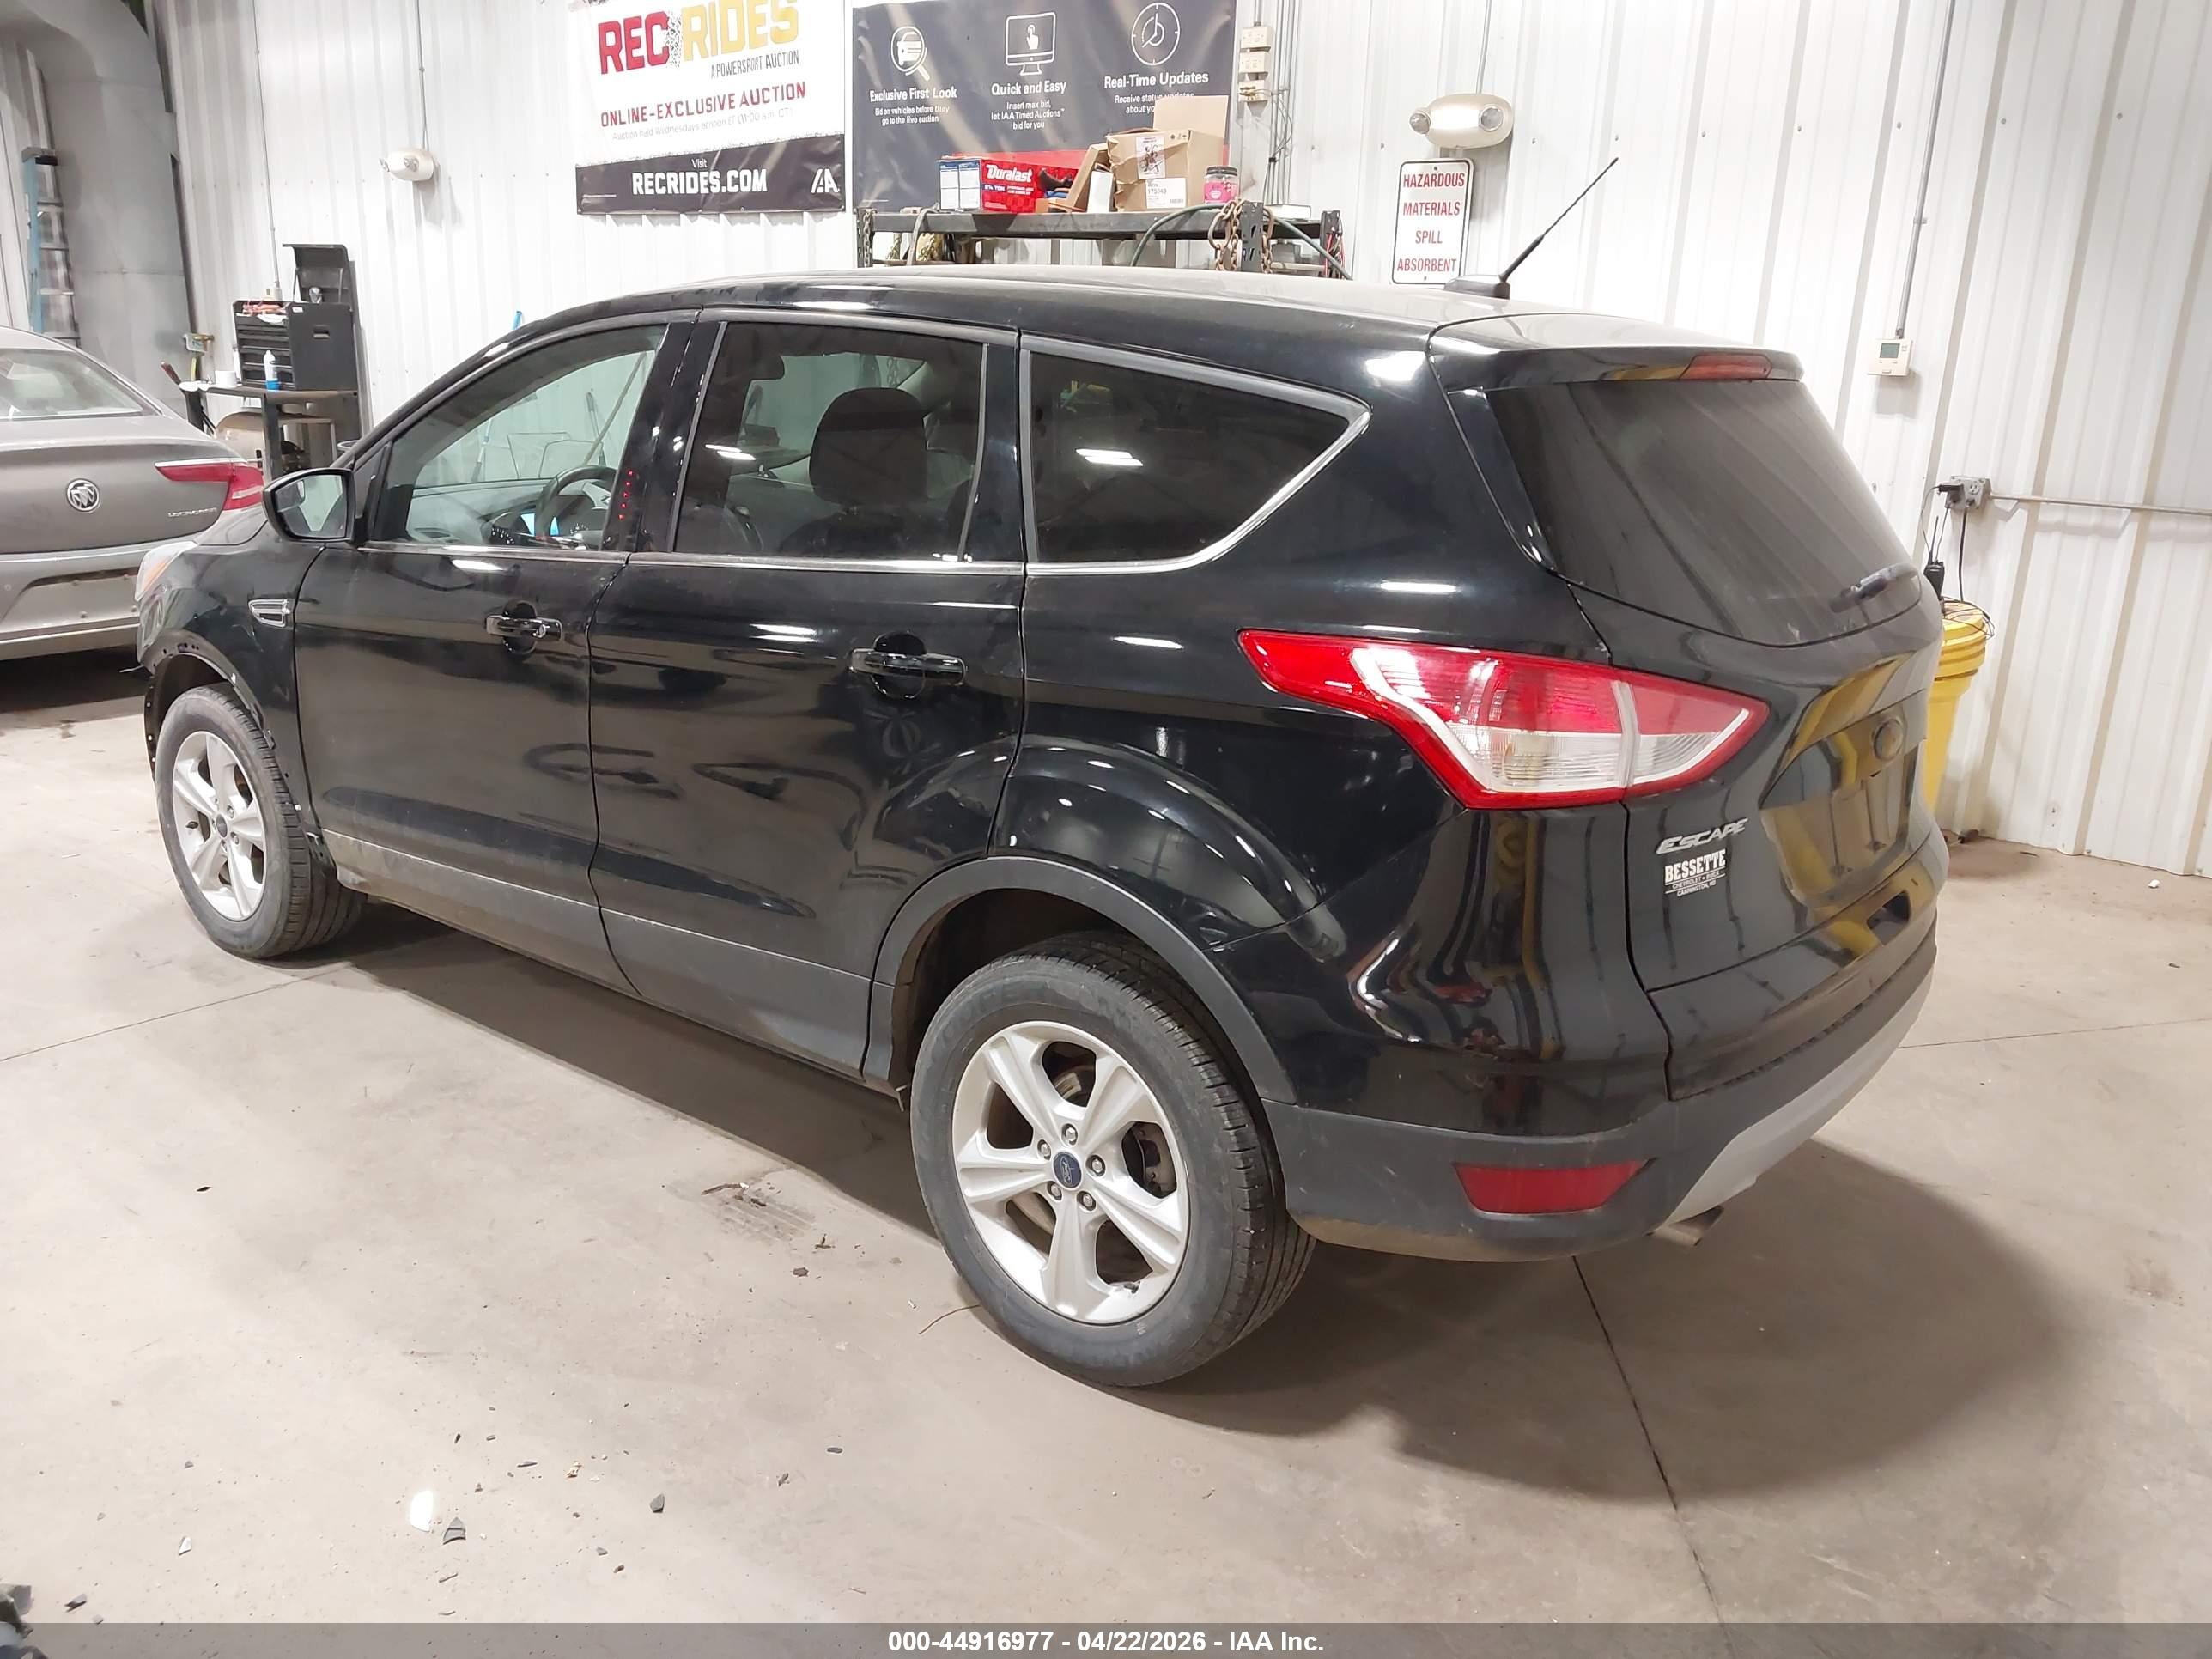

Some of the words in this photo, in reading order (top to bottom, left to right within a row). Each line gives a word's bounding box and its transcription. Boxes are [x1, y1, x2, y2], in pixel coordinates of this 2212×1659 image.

[598, 11, 670, 74] REC
[681, 0, 799, 61] RIDES
[711, 64, 715, 79] A
[716, 55, 763, 78] POWERSPORT
[765, 50, 799, 70] AUCTION
[1104, 74, 1156, 88] Real-Time
[1159, 71, 1209, 88] Updates
[869, 88, 908, 102] Exclusive
[909, 87, 929, 100] First
[933, 86, 957, 99] Look
[992, 82, 1021, 95] Quick
[1024, 81, 1042, 94] and
[1044, 80, 1066, 94] Easy
[601, 93, 736, 127] ONLINE-EXCLUSIVE
[739, 81, 805, 107] AUCTION
[1006, 101, 1024, 110] Insert
[1115, 94, 1140, 103] Receive
[891, 106, 915, 114] vehicles
[916, 105, 933, 113] before
[1126, 105, 1145, 113] about
[919, 114, 939, 124] auction
[1013, 121, 1023, 130] bid
[1024, 120, 1032, 129] for
[1033, 120, 1044, 130] you
[691, 159, 708, 169] Visit
[986, 164, 1033, 182] Duralast
[1403, 173, 1465, 188] HAZARDOUS
[632, 168, 768, 195] RECRIDES.COM
[1403, 201, 1461, 216] MATERIALS
[1415, 230, 1443, 244] SPILL
[1397, 258, 1457, 272] ABSORBENT
[1656, 817, 1748, 854] ESCAPE
[1665, 848, 1726, 883] BESSETTE
